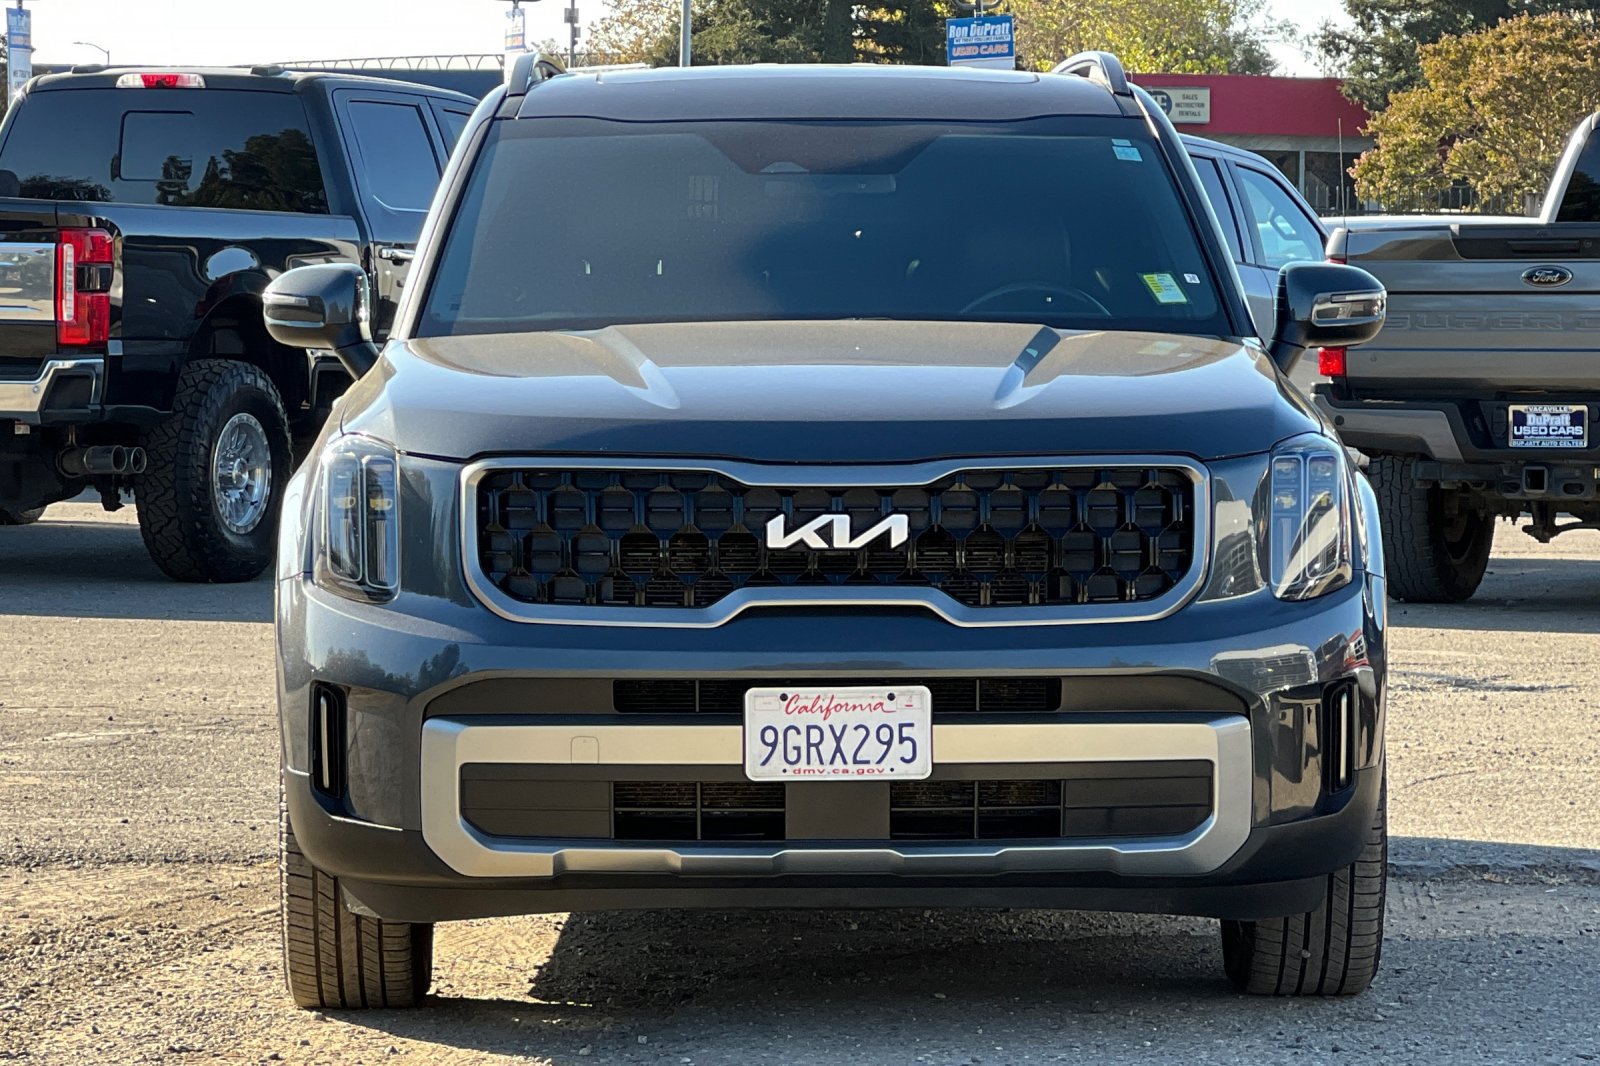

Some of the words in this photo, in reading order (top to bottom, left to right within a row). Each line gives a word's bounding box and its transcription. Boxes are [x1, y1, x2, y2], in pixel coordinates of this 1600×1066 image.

[1532, 270, 1560, 283] Ford
[1526, 414, 1570, 426] DuPratt
[1514, 426, 1547, 435] USED
[1549, 426, 1583, 435] CARS
[766, 513, 909, 549] KIA
[784, 693, 896, 721] California
[760, 722, 917, 766] 9GRX295
[792, 766, 886, 775] dmv.ca.gov
